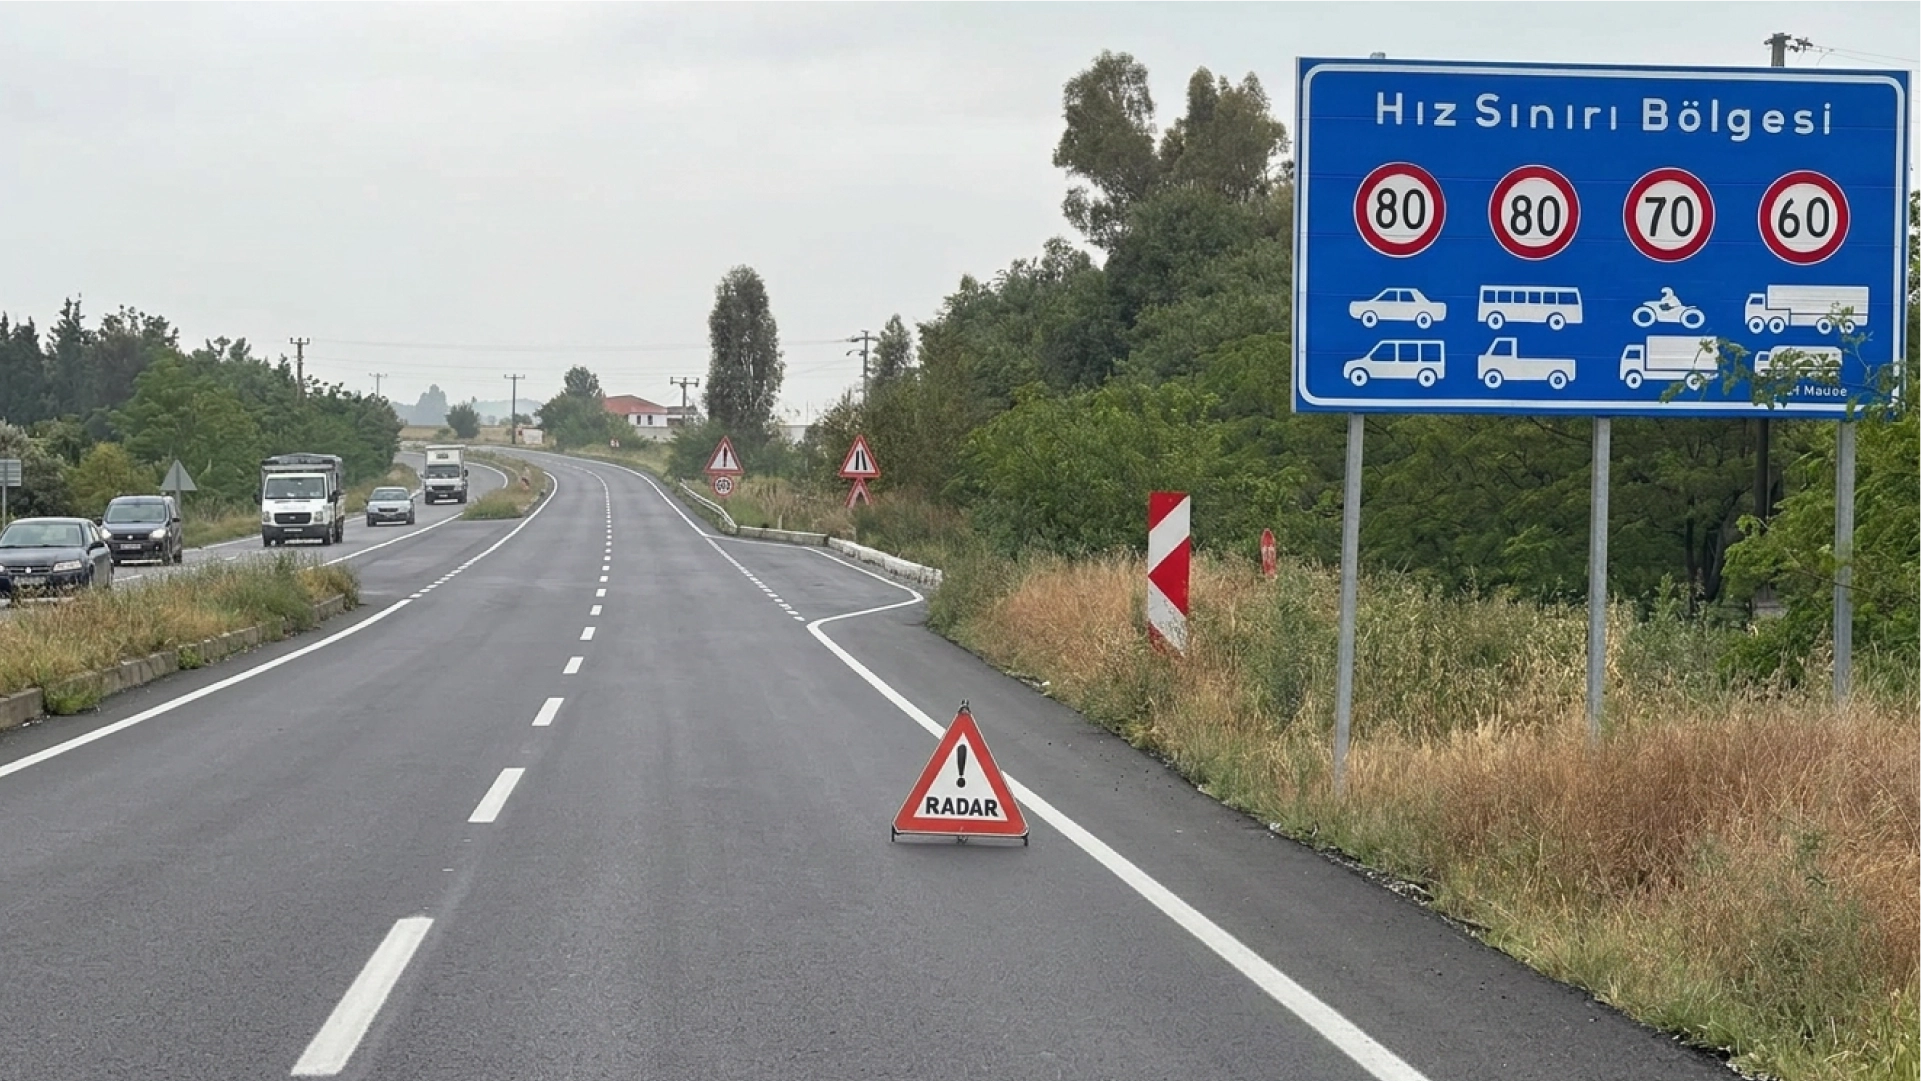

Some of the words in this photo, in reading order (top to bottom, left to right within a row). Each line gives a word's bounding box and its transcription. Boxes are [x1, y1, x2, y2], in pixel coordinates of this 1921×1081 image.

[1376, 92, 1456, 127] Hız
[1475, 93, 1618, 131] Sınırı
[1642, 98, 1832, 142] Bölgesi
[1375, 187, 1427, 230] 80
[1510, 194, 1562, 237] 80
[1644, 195, 1695, 238] 70
[1777, 197, 1830, 239] 60
[925, 796, 999, 817] RADAR
